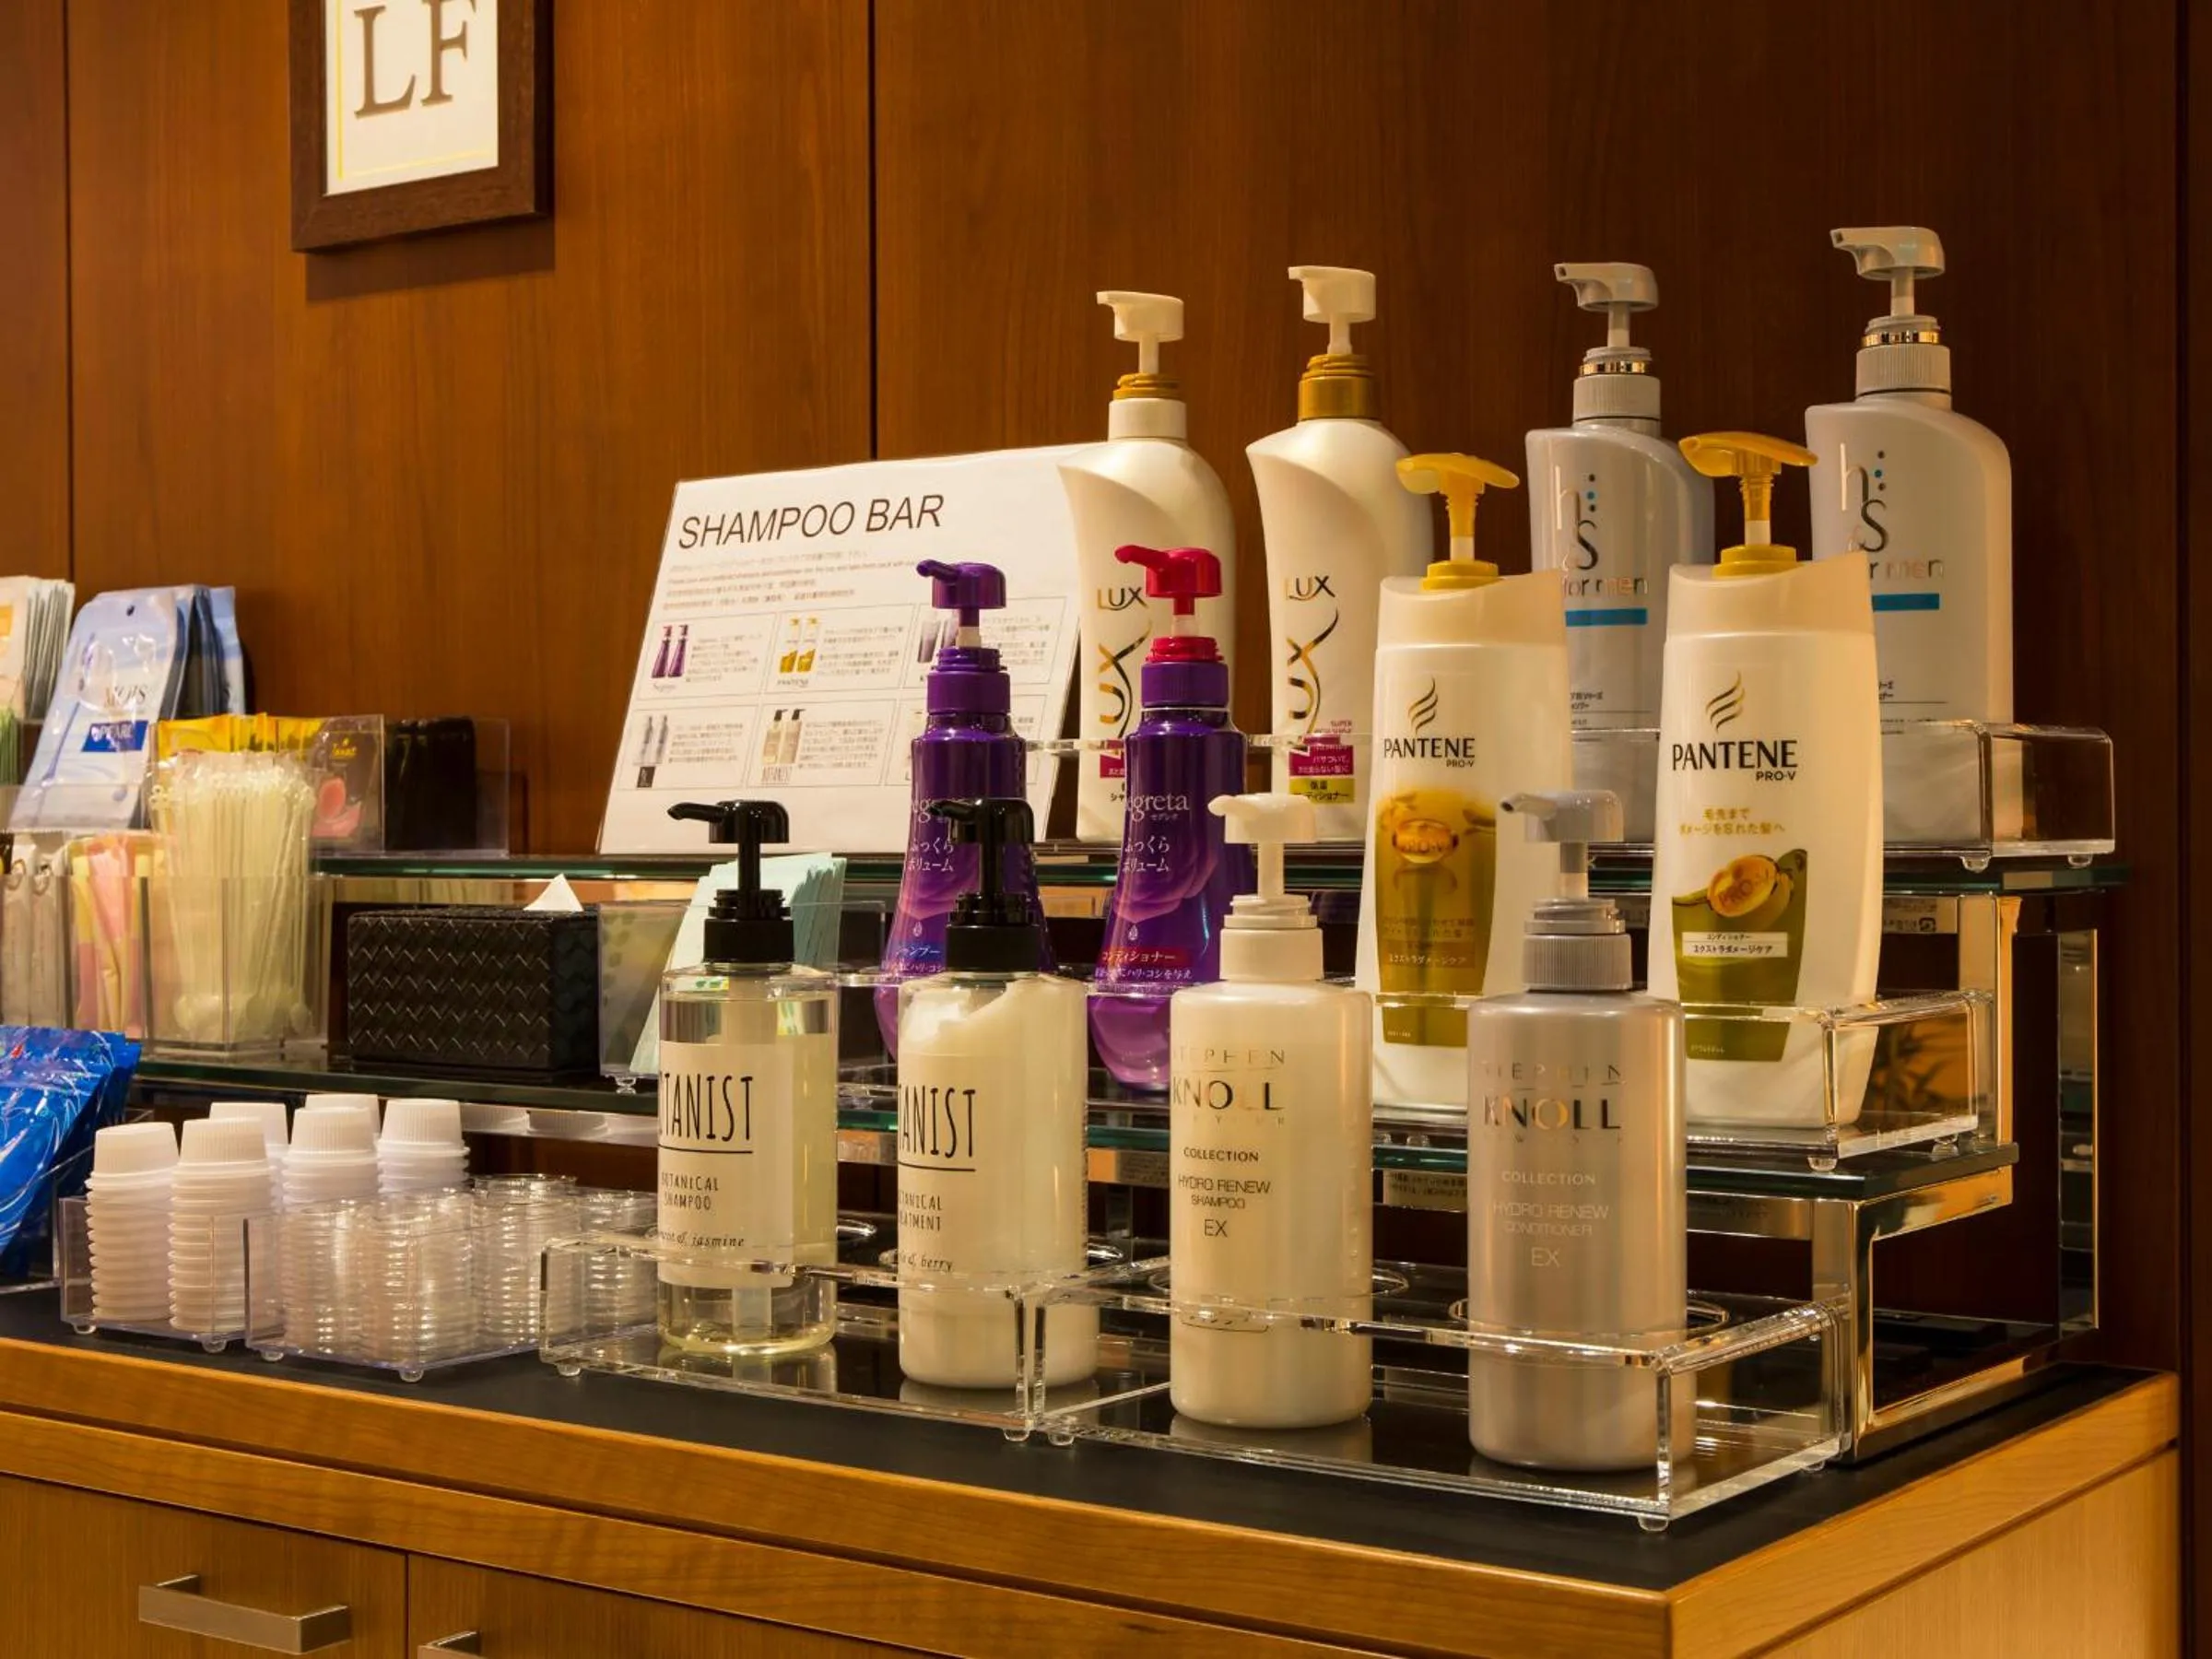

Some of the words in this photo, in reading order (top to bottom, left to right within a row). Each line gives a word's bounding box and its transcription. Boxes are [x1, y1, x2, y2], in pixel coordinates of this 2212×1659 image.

[678, 500, 855, 549] SHAMPOO
[865, 495, 945, 532] BAR
[1098, 587, 1148, 610] LUX
[1285, 575, 1335, 600] LUX
[1383, 737, 1475, 758] PANTENE
[1672, 740, 1799, 771] PANTENE
[1482, 1094, 1623, 1131] KNOLL
[1182, 1147, 1260, 1162] COLLECTION
[1217, 1179, 1272, 1194] RENEW
[1500, 1170, 1596, 1185] COLLECTION
[1204, 1218, 1229, 1238] EX
[1531, 1246, 1561, 1268] EX
